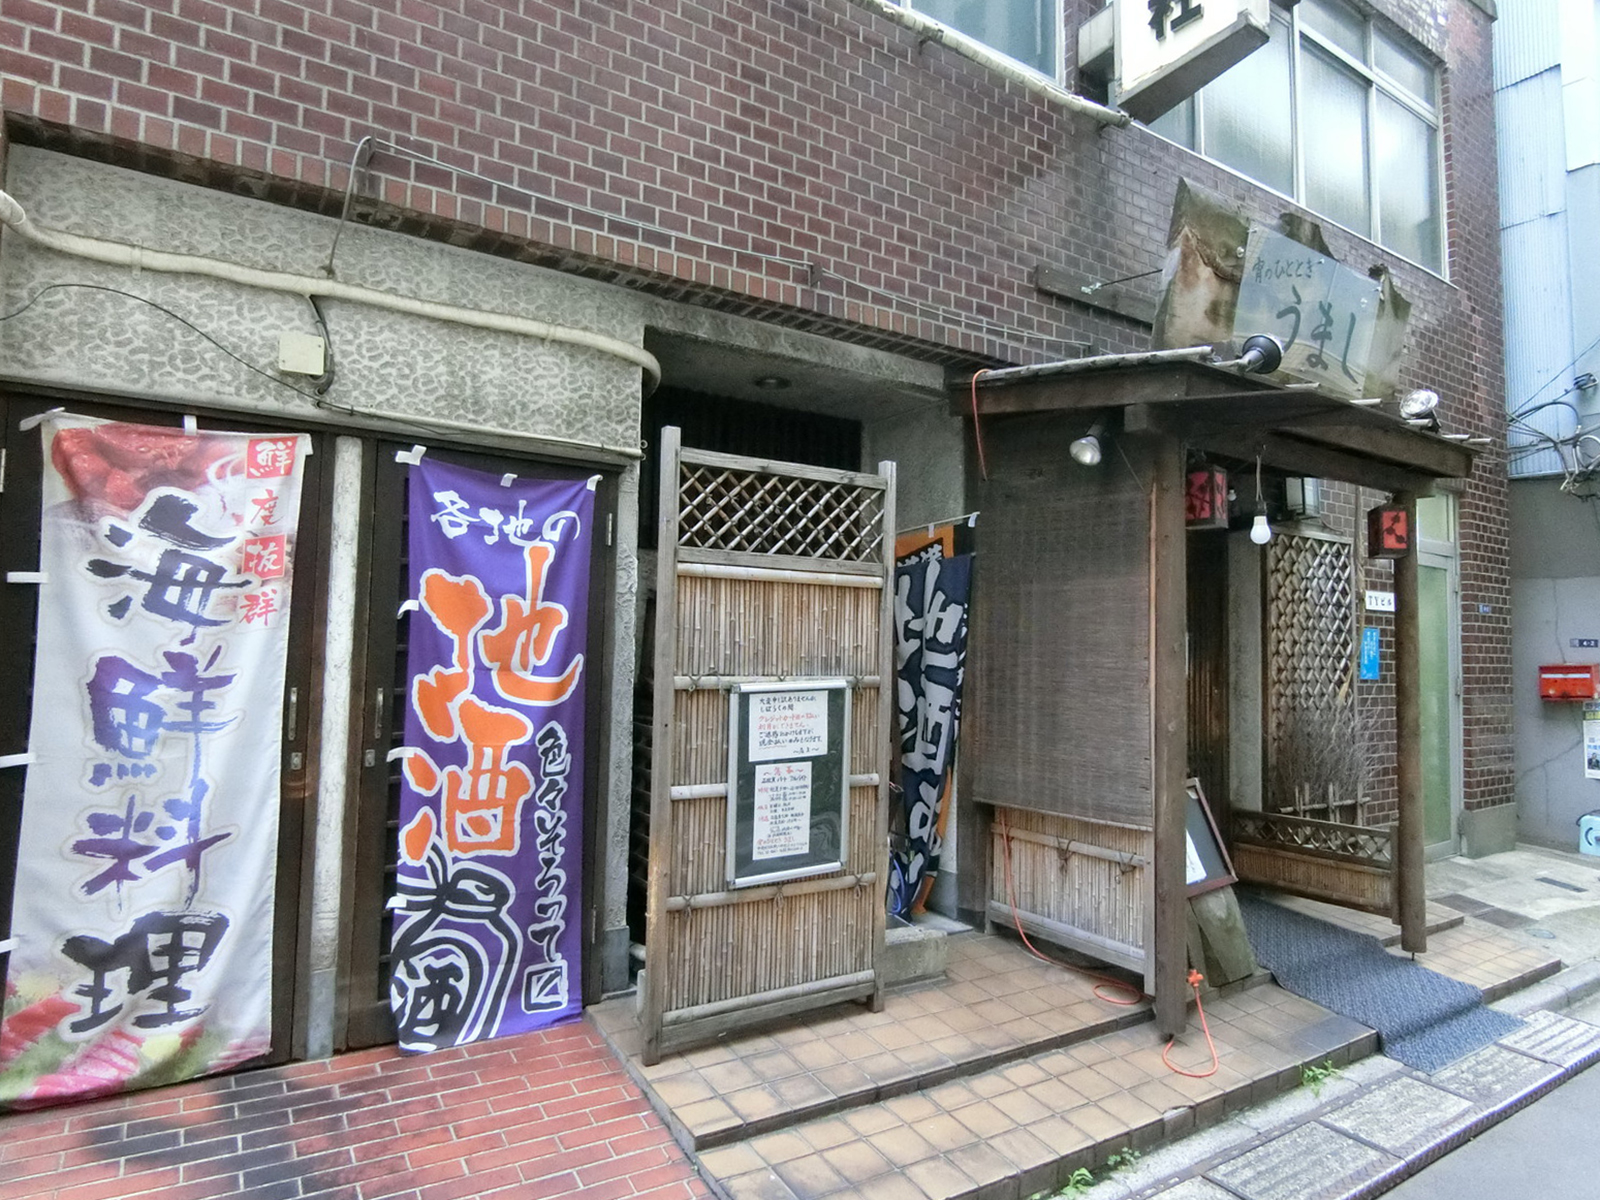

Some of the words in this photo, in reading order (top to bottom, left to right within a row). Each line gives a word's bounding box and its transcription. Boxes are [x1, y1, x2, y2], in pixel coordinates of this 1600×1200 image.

[1252, 258, 1318, 283] 宵のひととき
[1277, 285, 1358, 384] うまし
[239, 441, 294, 626] 鮮度抜群
[430, 490, 581, 546] 各地の
[61, 494, 252, 1032] 海鮮料理
[403, 543, 584, 862] 地酒
